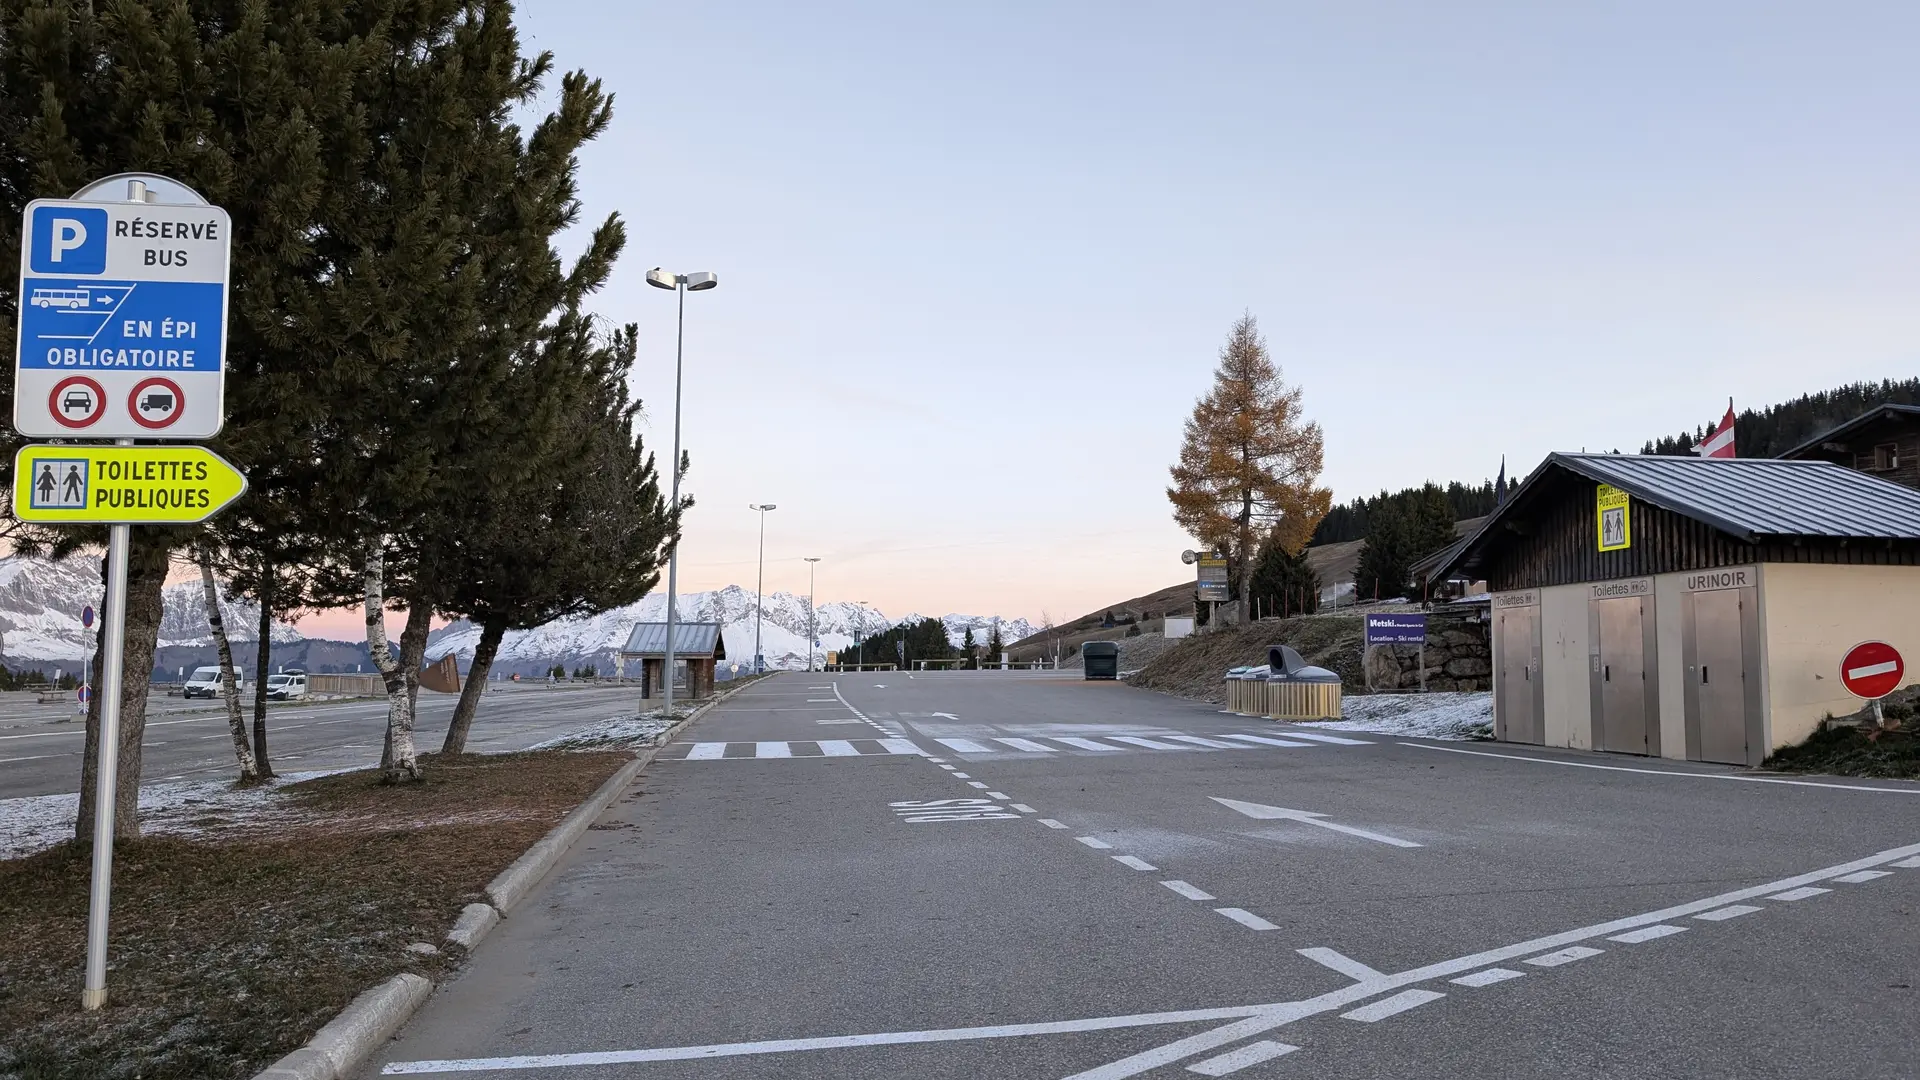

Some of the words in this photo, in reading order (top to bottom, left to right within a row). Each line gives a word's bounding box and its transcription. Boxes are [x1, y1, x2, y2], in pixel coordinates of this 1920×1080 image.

[115, 217, 218, 241] RÉSERVÉ
[51, 218, 88, 263] P
[143, 249, 188, 267] BUS
[123, 320, 152, 338] EN
[161, 317, 196, 339] ÉPI
[46, 347, 196, 368] OBLIGATOIRE
[95, 460, 208, 481] TOILETTES
[95, 488, 210, 509] PUBLIQUES
[1599, 493, 1628, 508] PUBLIQUES
[1592, 584, 1629, 597] Toilettes
[1687, 571, 1746, 590] URINOIR
[1495, 595, 1524, 607] Toilettes
